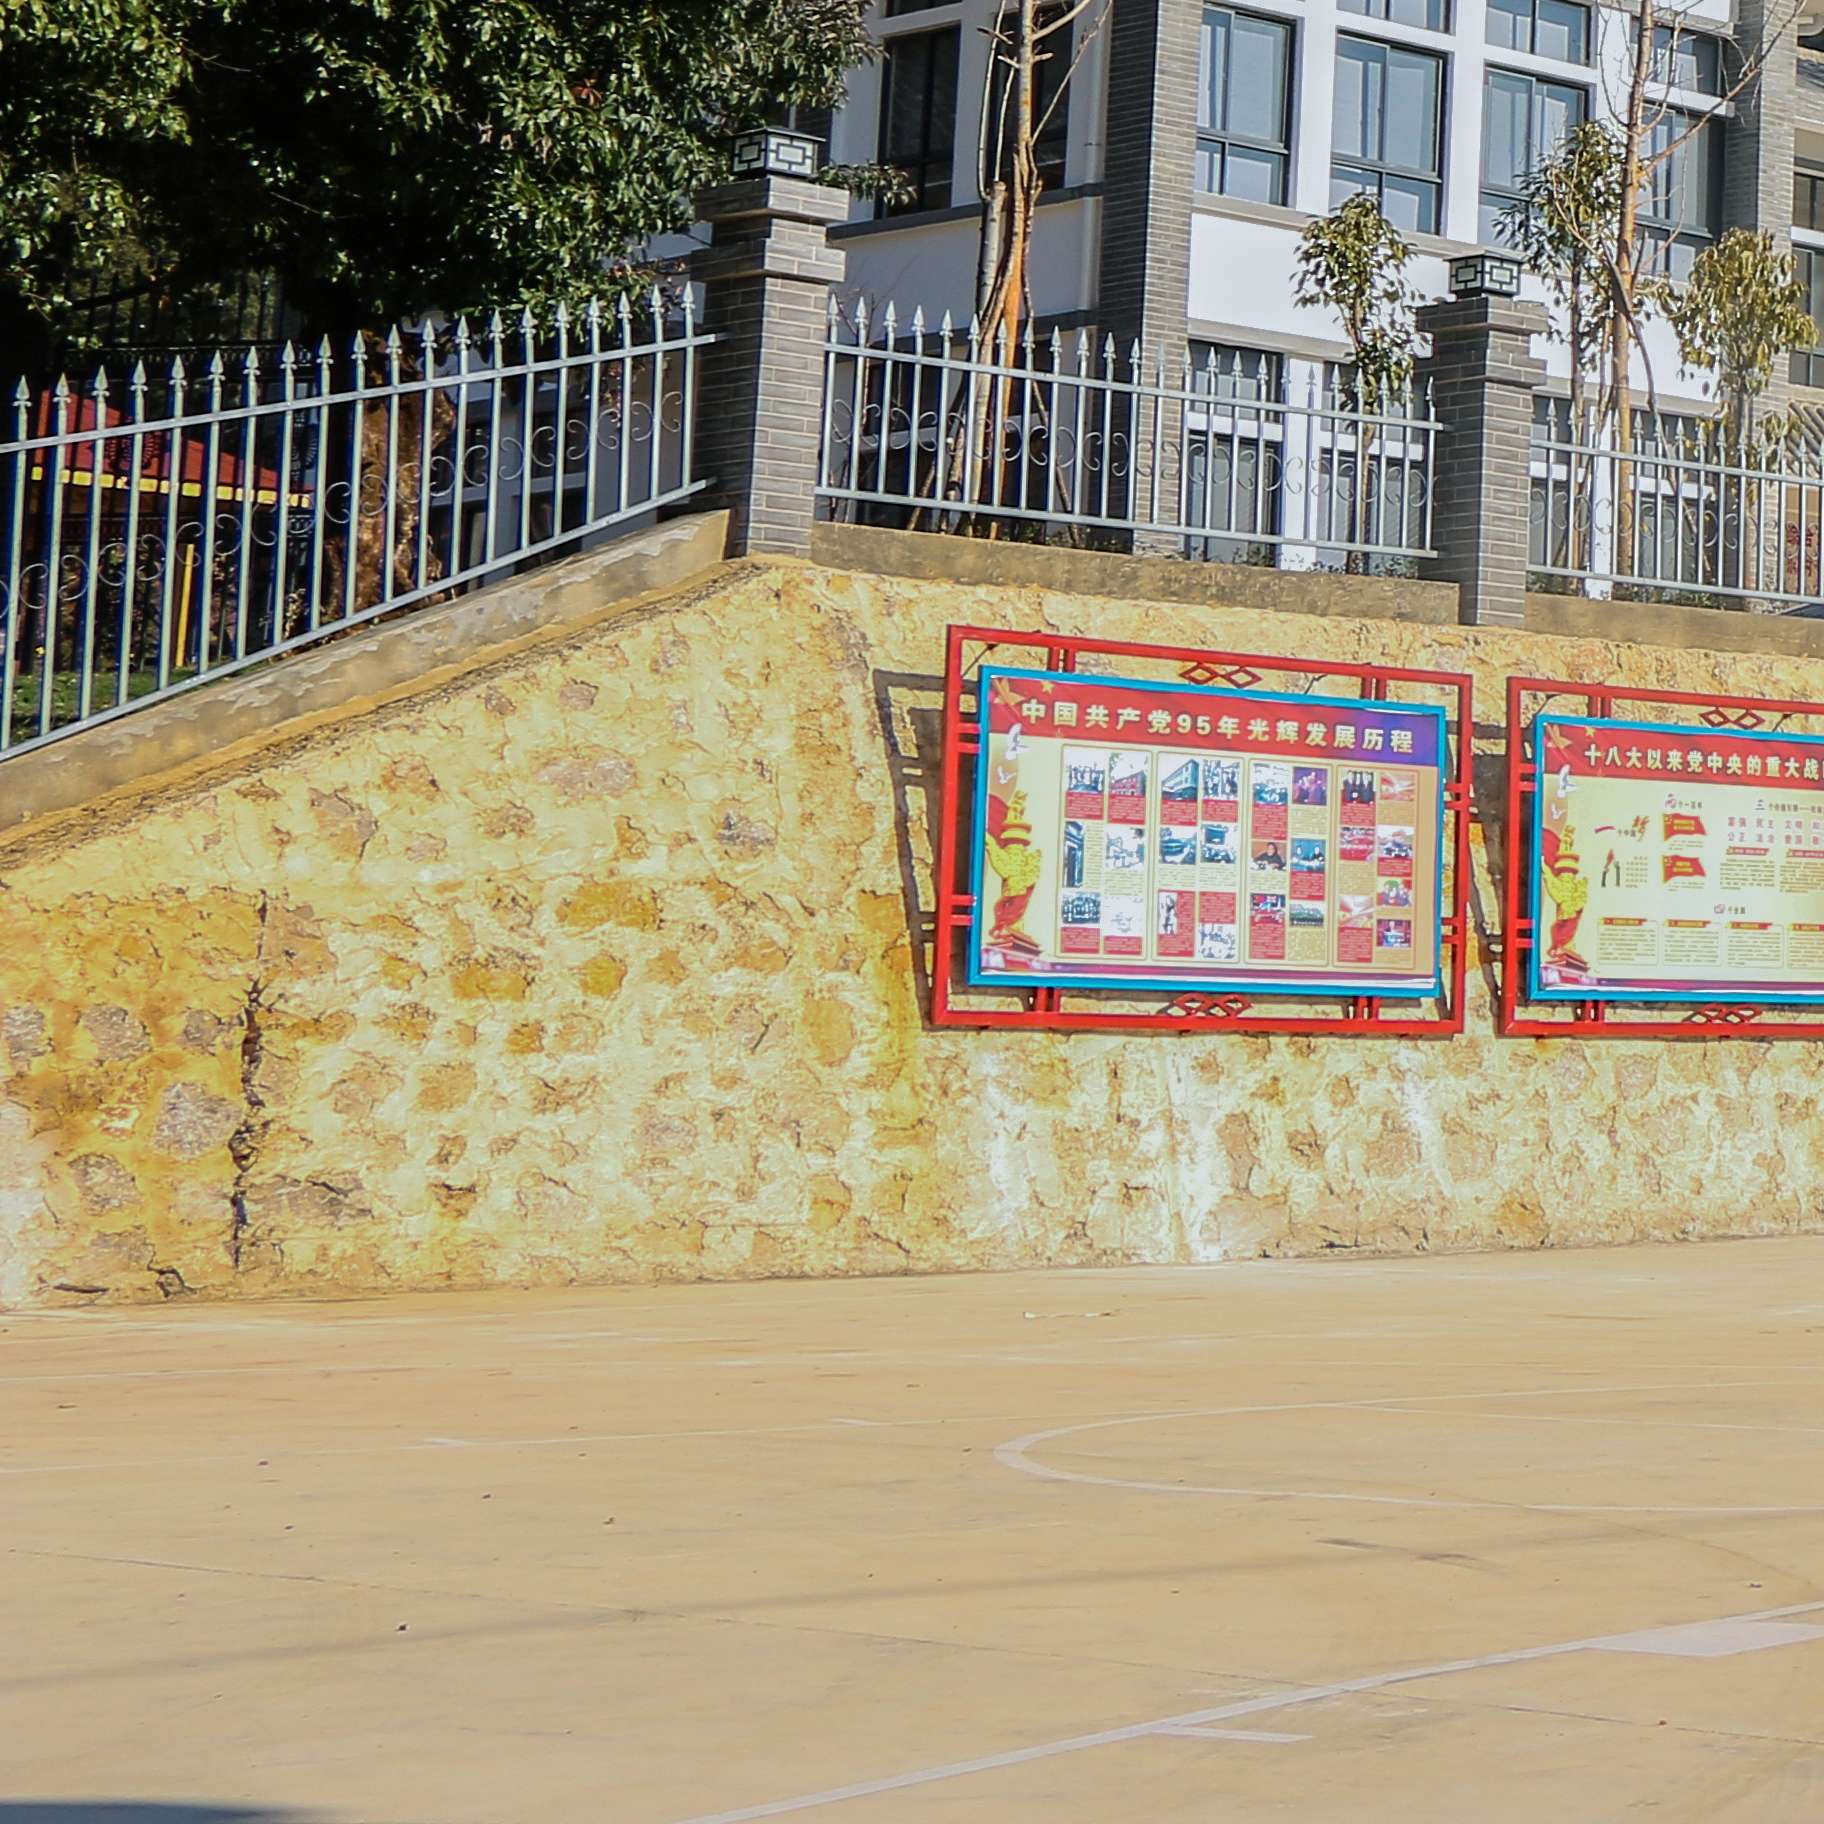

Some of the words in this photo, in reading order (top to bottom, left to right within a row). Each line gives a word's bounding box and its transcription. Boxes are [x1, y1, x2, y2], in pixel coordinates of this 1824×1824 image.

[1020, 698, 1415, 754] 中国共产党95年光辉发展历程
